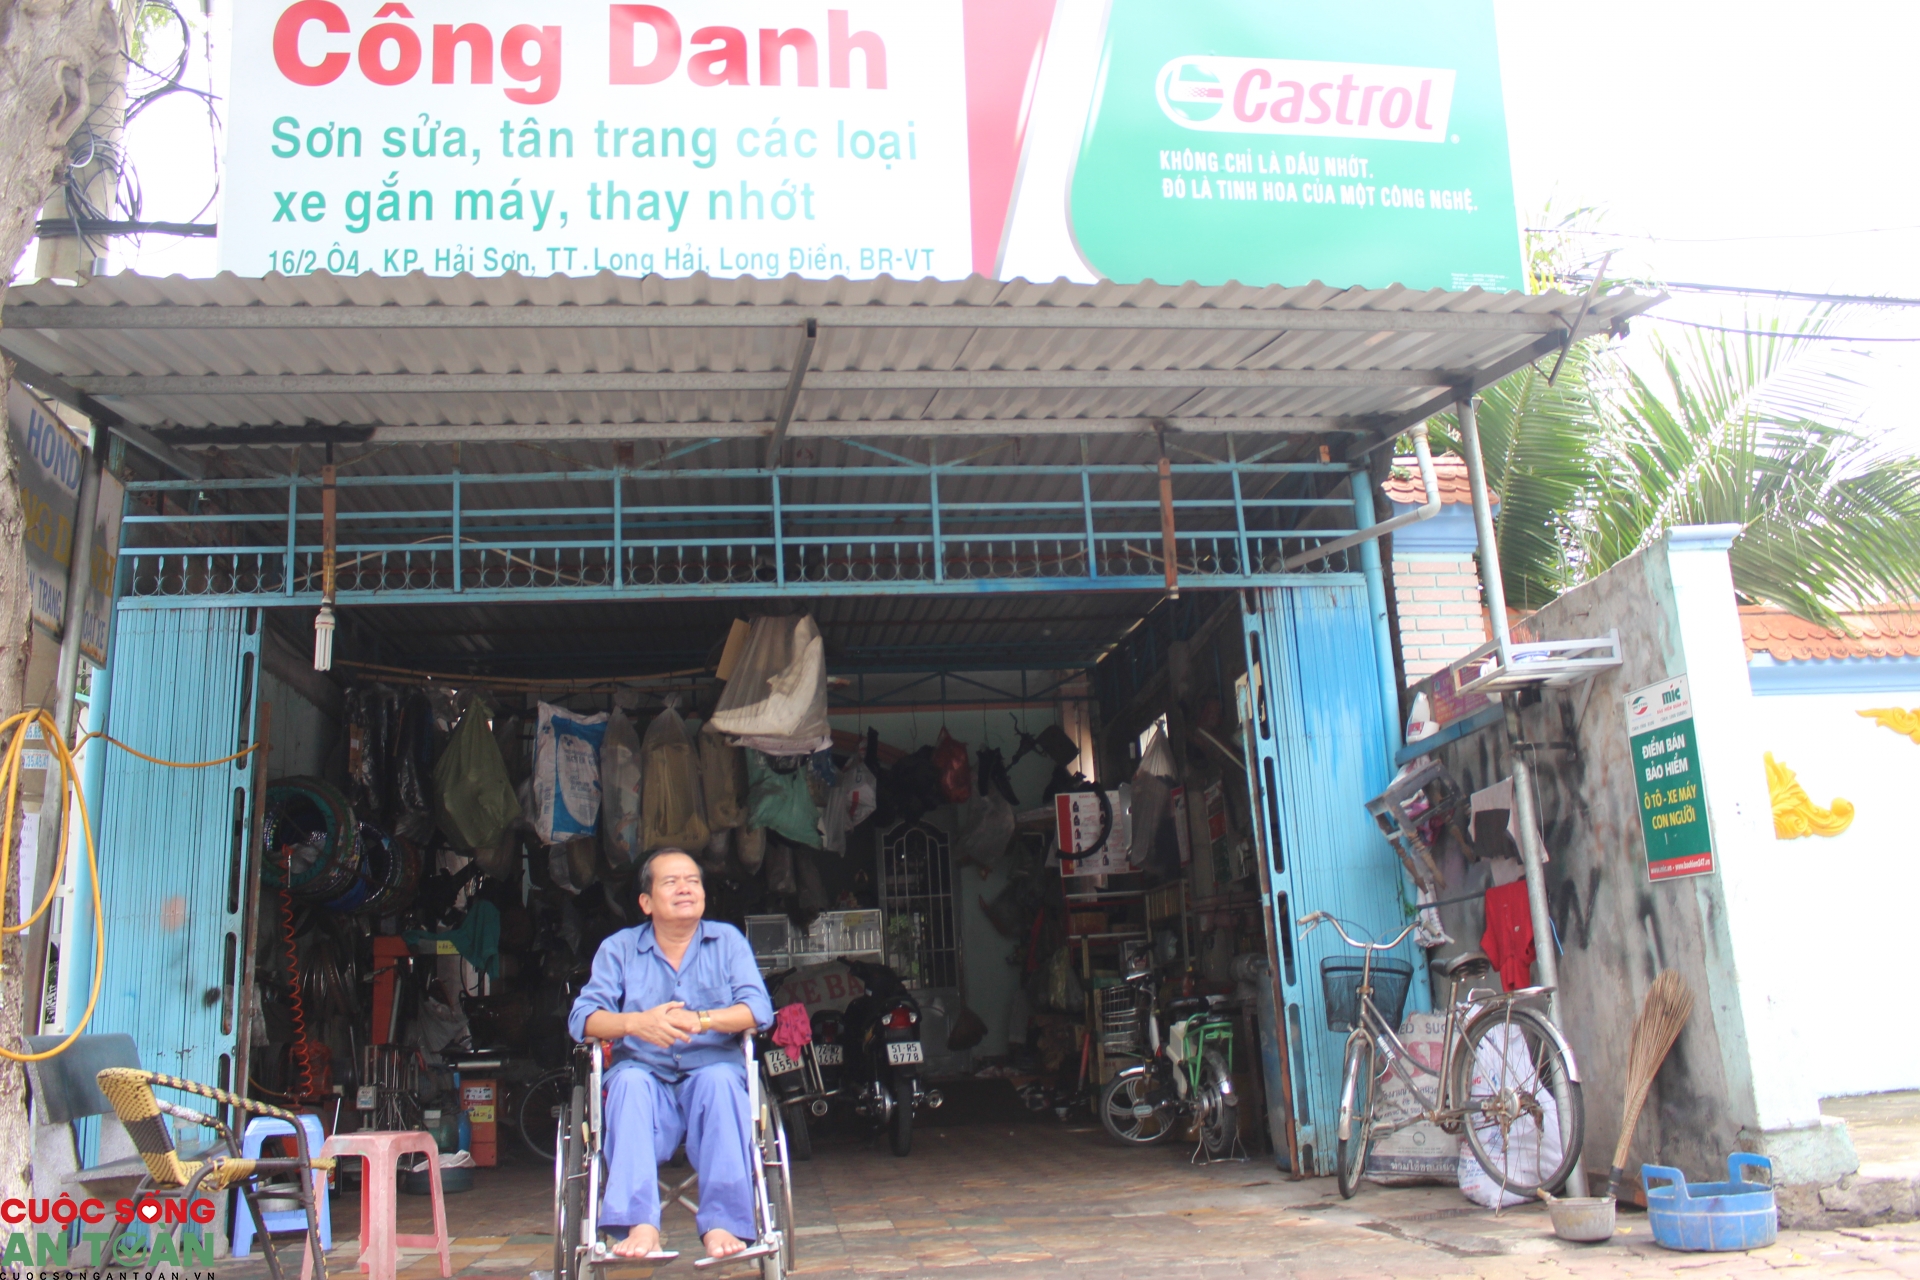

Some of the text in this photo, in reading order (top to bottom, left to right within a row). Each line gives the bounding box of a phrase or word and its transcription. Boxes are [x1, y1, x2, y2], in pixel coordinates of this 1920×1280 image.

[272, 0, 889, 105] Công Danh
[1233, 67, 1435, 131] Castrol
[270, 114, 918, 170] Sơn sửa, tân trang các loại
[1159, 147, 1219, 172] KHÔNG
[1225, 148, 1253, 174] CHỈ
[1258, 151, 1280, 175] LÀ
[272, 170, 816, 234] xe gắn máy, thay nhớt
[1161, 173, 1186, 199] ĐÓ
[1191, 174, 1213, 200] LÀ
[1217, 180, 1258, 201] TINH
[1263, 182, 1298, 203] HOA
[1302, 177, 1336, 205] CỦA
[1340, 183, 1376, 209] MỘT
[1380, 185, 1425, 209] CÔNG
[269, 249, 317, 273] 16/2
[435, 244, 475, 272] Hải
[484, 246, 536, 276] Sơn,
[664, 243, 711, 273] Hải,
[720, 247, 780, 276] Long
[789, 243, 850, 275] Điền,
[860, 248, 935, 271] BR-VT
[26, 407, 83, 491] HOND
[1661, 683, 1681, 705] mic
[1641, 732, 1686, 760] ĐIỂM BÁN
[1645, 754, 1688, 782] BẢO HIỂM
[1644, 789, 1651, 810] Ô
[1651, 785, 1662, 807] TÔ
[1667, 789, 1678, 805] XE
[1678, 781, 1697, 802] MÁY
[1652, 805, 1697, 830] CON NGƯỜI
[782, 979, 822, 1005] XE
[893, 1052, 919, 1063] 9778
